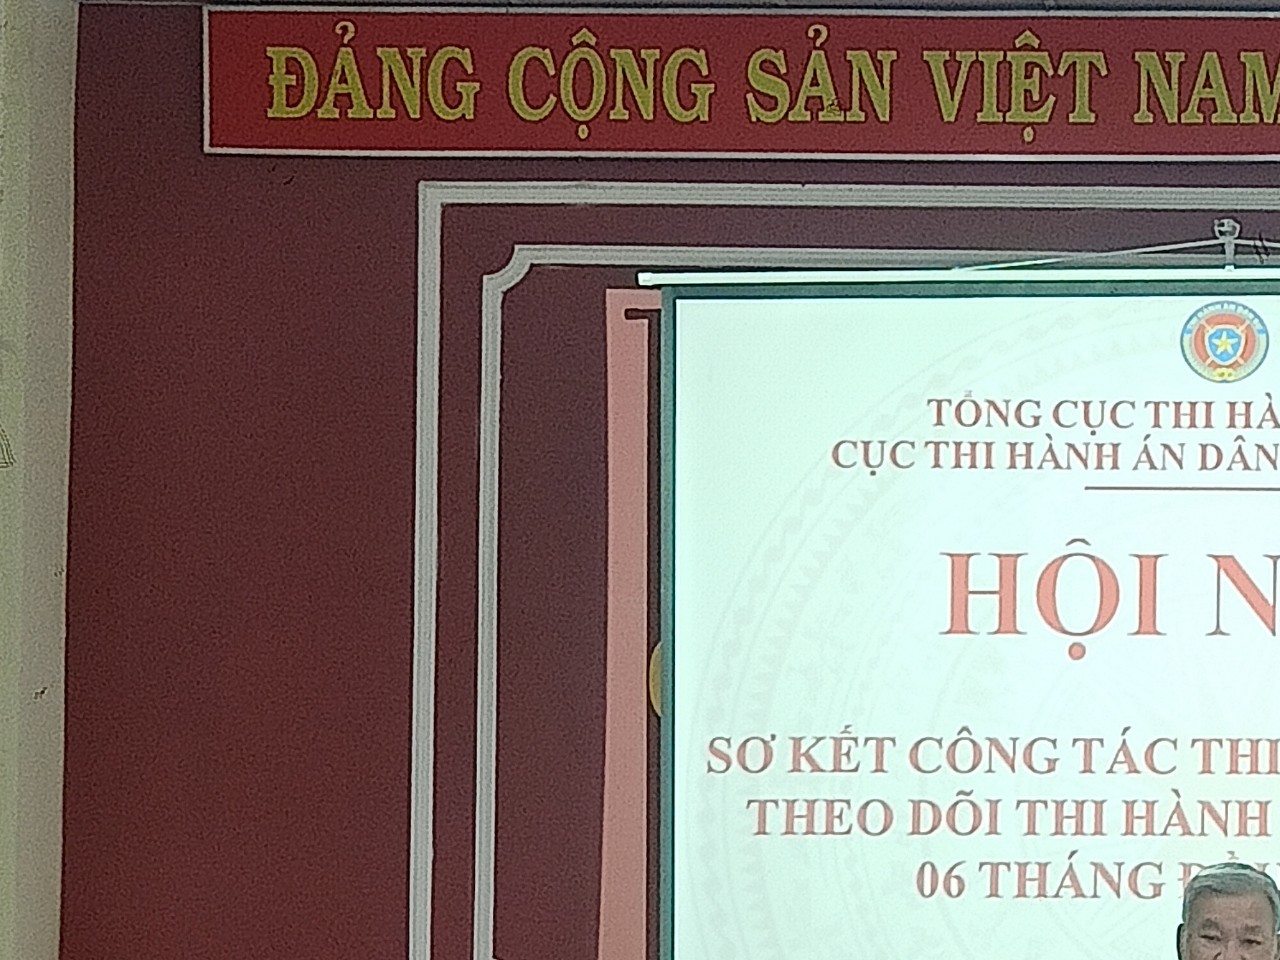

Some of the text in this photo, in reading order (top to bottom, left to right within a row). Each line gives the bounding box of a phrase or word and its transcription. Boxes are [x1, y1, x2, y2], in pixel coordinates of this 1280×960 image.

[267, 22, 480, 120] ĐẢNG
[508, 30, 714, 139] CỘNG
[747, 26, 896, 123] SẢN
[923, 30, 1106, 141] VIỆT
[926, 390, 1042, 429] TỔNG
[1052, 399, 1136, 437] CỤC
[1144, 400, 1215, 429] THI
[831, 439, 916, 478] CỤC
[924, 440, 995, 470] THI
[1006, 433, 1122, 471] HÀNH
[1132, 434, 1186, 471] ÁN
[1198, 434, 1280, 472] DÂN
[939, 537, 1169, 661] HỘI
[706, 734, 777, 775] SƠ
[788, 724, 896, 774] KẾT
[908, 726, 1060, 775] CÔNG
[1072, 726, 1178, 775] TÁC
[745, 798, 894, 837] THEO
[907, 789, 1002, 837] DÕI
[1015, 799, 1108, 837] THI
[1120, 788, 1273, 838] HÀNH
[916, 860, 967, 899] 06
[978, 850, 1166, 900] THÁNG
